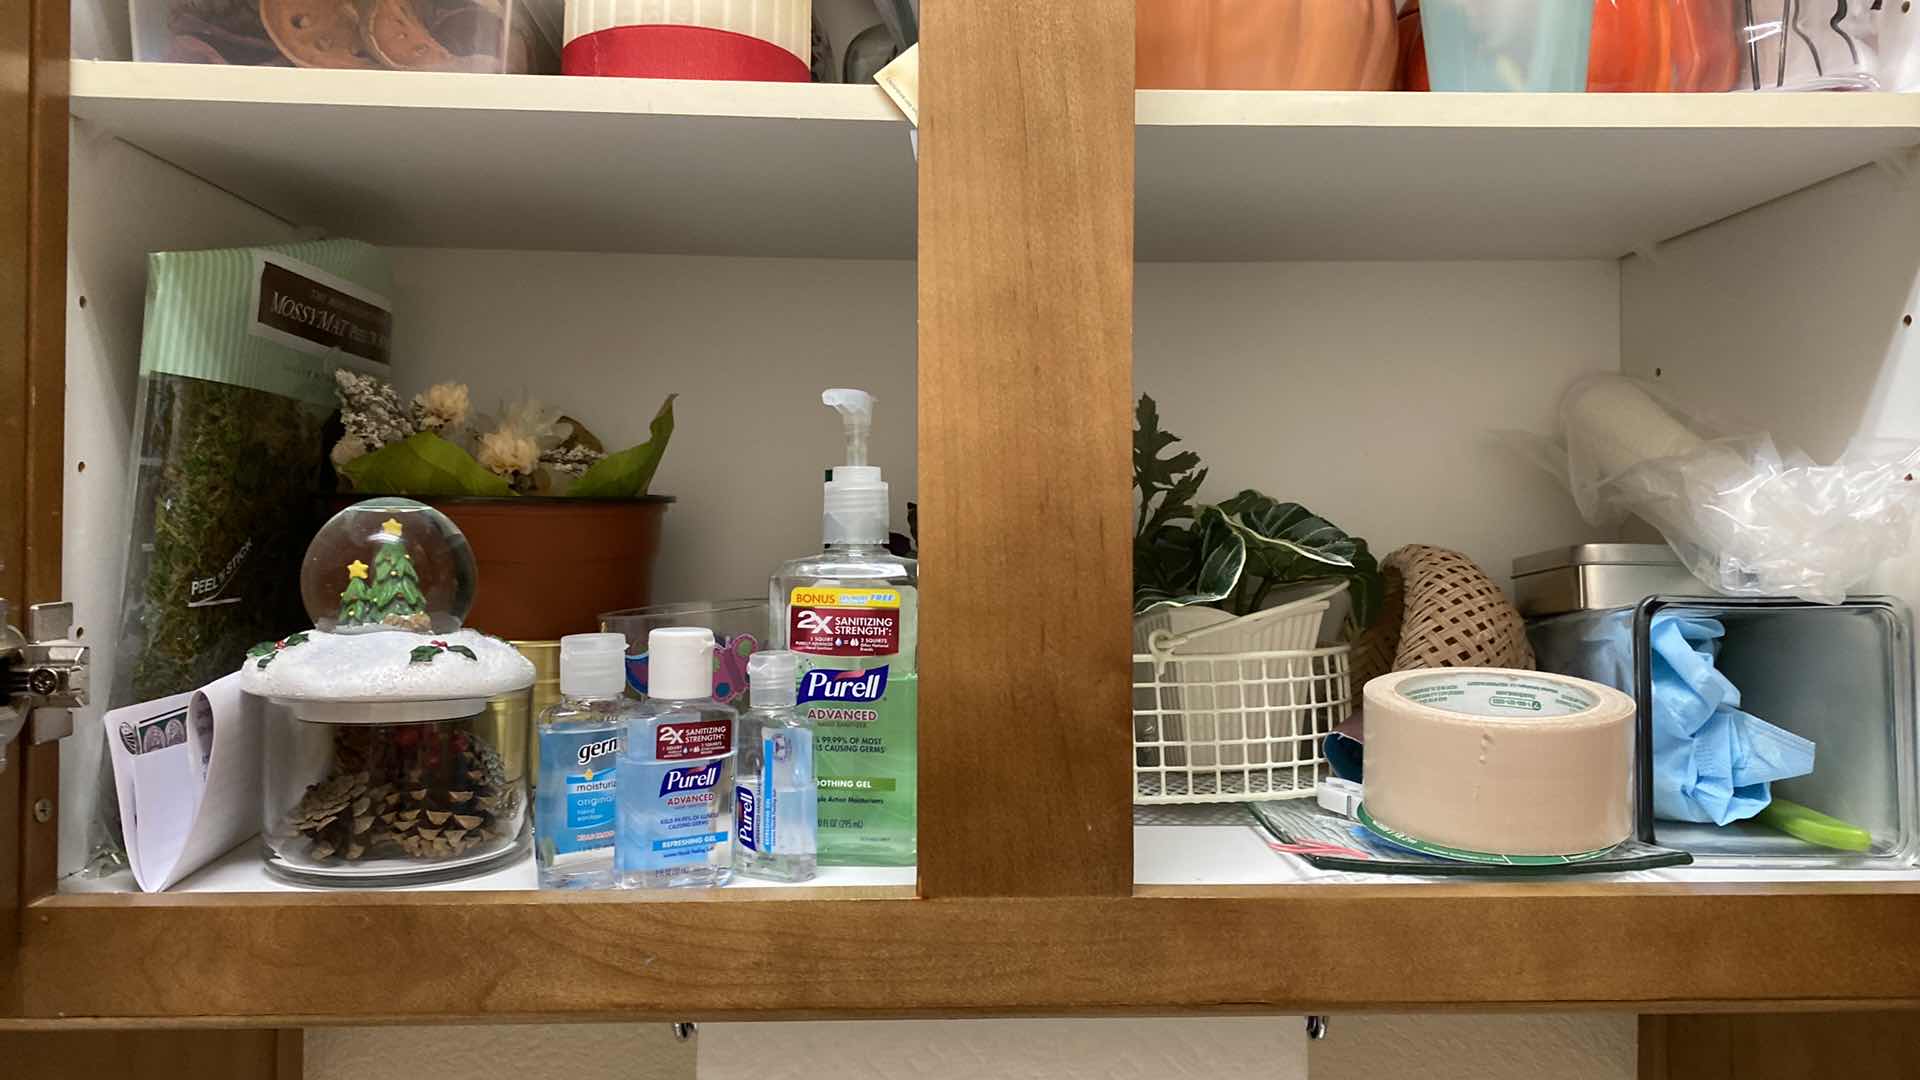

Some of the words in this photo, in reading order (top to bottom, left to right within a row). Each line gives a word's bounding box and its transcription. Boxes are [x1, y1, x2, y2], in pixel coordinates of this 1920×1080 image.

[192, 578, 218, 596] PEEL
[796, 594, 836, 604] BONUS
[797, 610, 834, 634] 2X
[835, 617, 893, 626] SANITIZING
[808, 672, 881, 698] Purell
[808, 709, 878, 721] ADVANCED
[659, 726, 684, 744] 2X
[686, 726, 726, 736] SANITIZING
[667, 767, 717, 790] Purell
[667, 794, 714, 806] ADVANCED
[739, 792, 753, 842] Purell
[662, 836, 703, 848] REFRESHING
